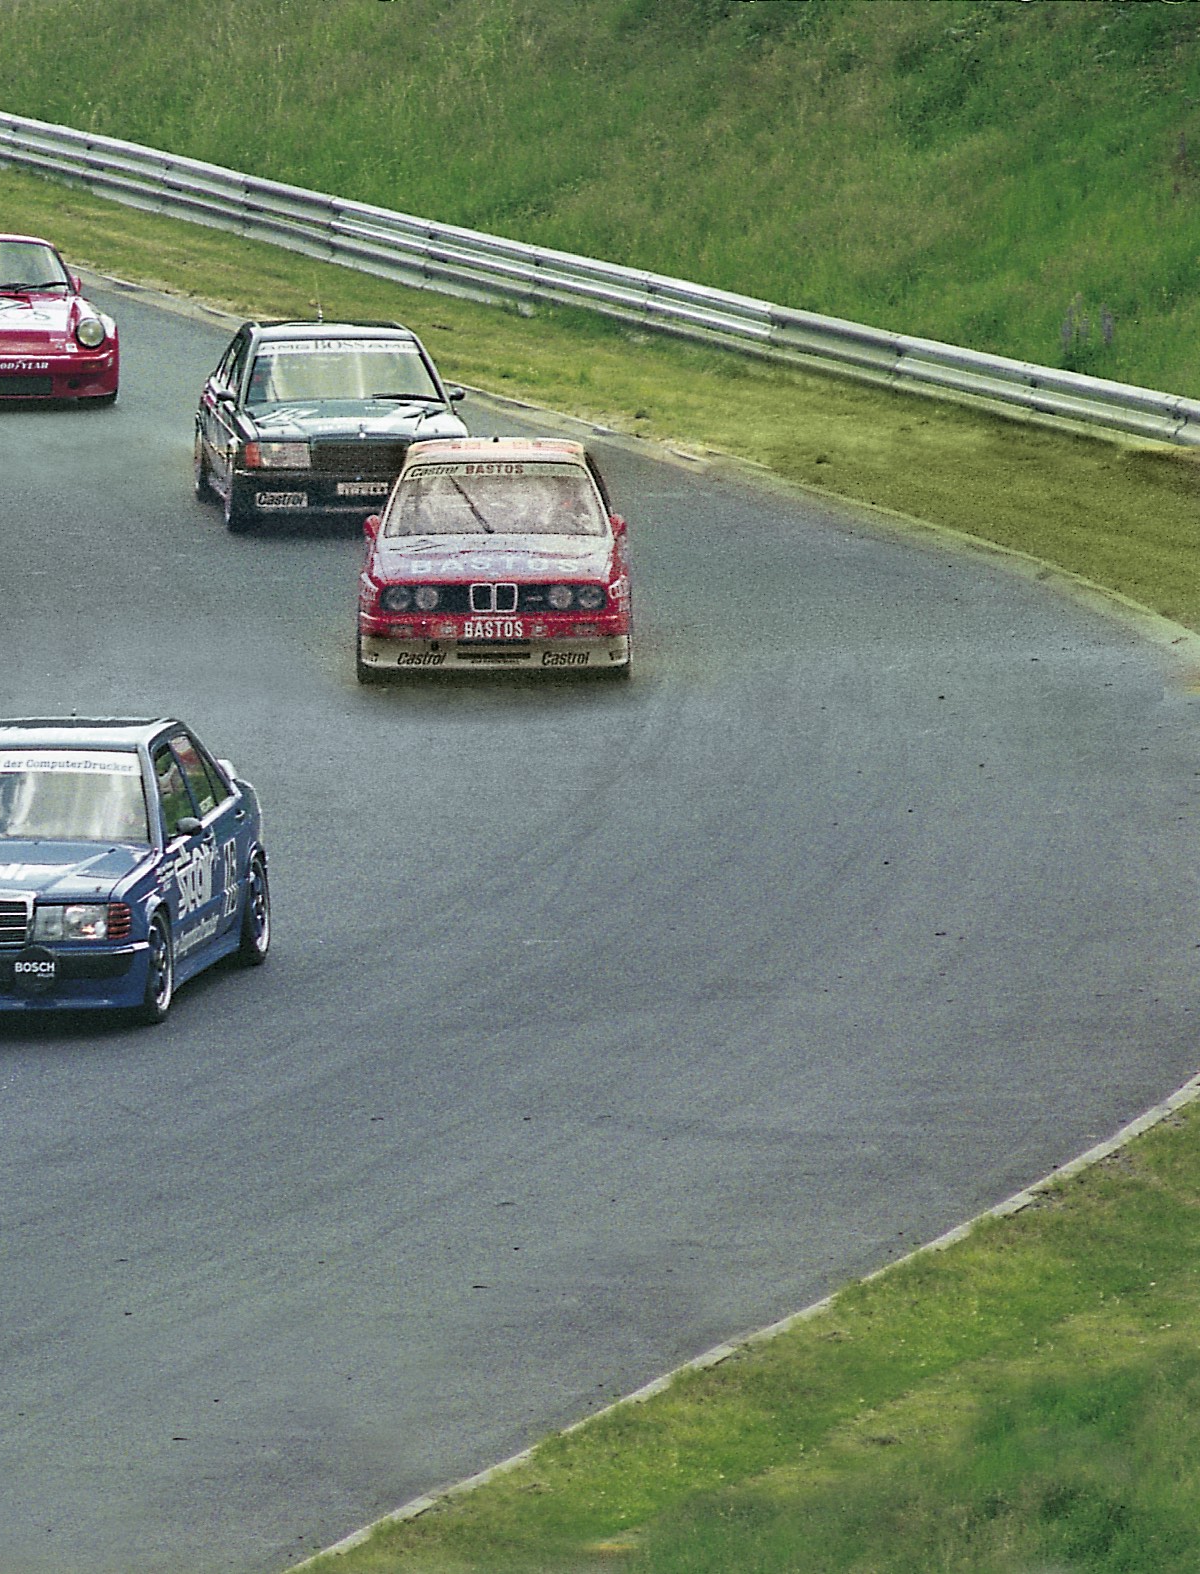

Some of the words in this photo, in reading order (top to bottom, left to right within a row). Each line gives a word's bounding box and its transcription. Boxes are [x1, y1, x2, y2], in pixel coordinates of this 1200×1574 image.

[313, 340, 366, 349] BOSS
[411, 466, 458, 478] Castrol
[465, 464, 524, 475] BASTOS
[257, 492, 304, 506] Castrol
[411, 559, 581, 574] BASTOS
[464, 621, 523, 638] BASTOS
[397, 651, 447, 666] Castrol
[541, 651, 590, 666] Castrol
[3, 760, 22, 768] der
[14, 961, 55, 973] BOSCH
